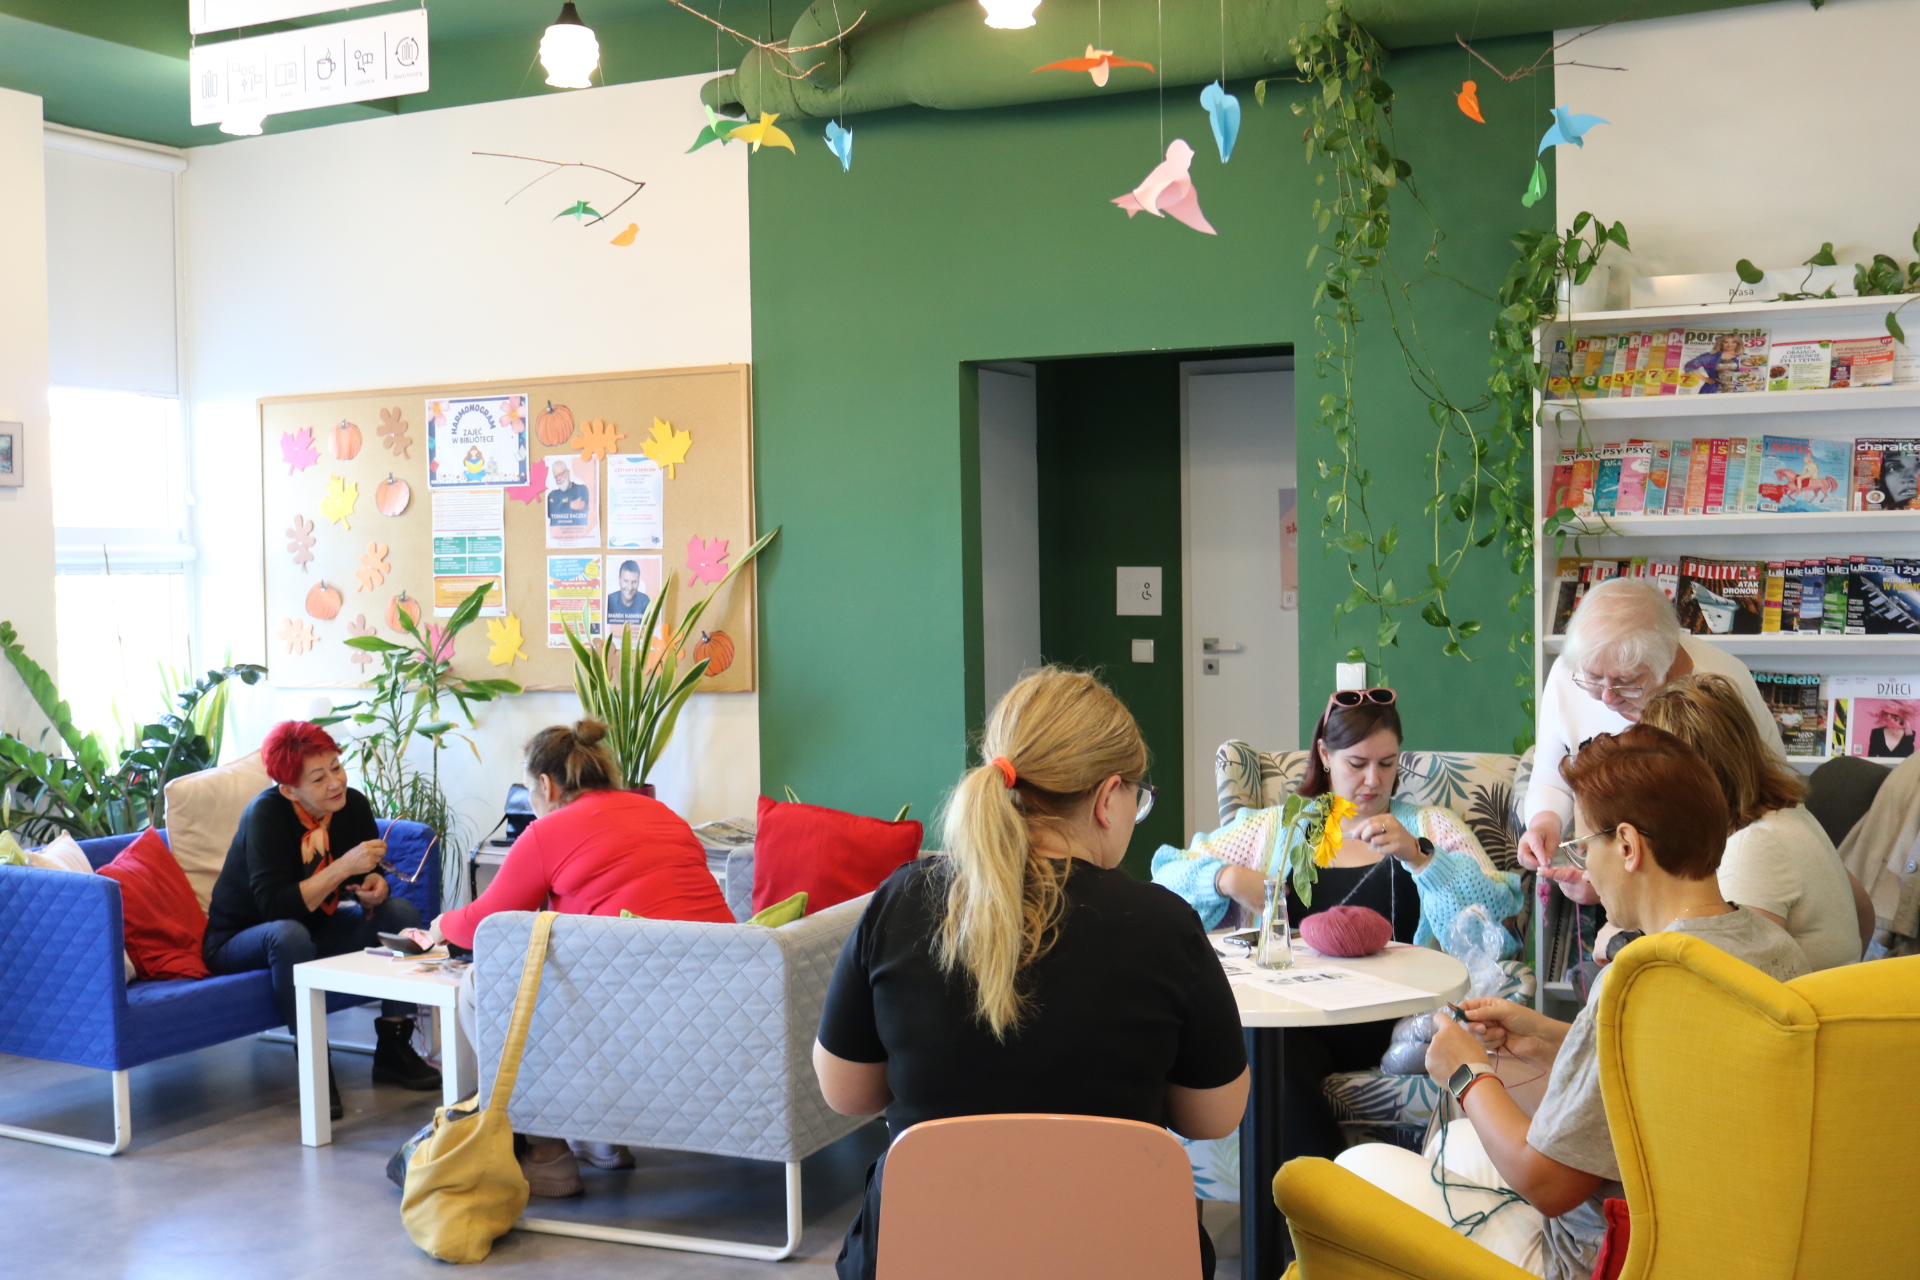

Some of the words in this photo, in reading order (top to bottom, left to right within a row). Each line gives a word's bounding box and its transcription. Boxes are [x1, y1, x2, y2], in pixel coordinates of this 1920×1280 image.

[1744, 337, 1766, 348] 35
[451, 404, 497, 435] HARMONOGRAM
[460, 436, 494, 444] BIBLIOTECE
[1771, 443, 1812, 455] sens
[1903, 565, 1920, 576] ŻY
[1752, 672, 1820, 686] ierciadło
[1877, 683, 1911, 695] DZIECI
